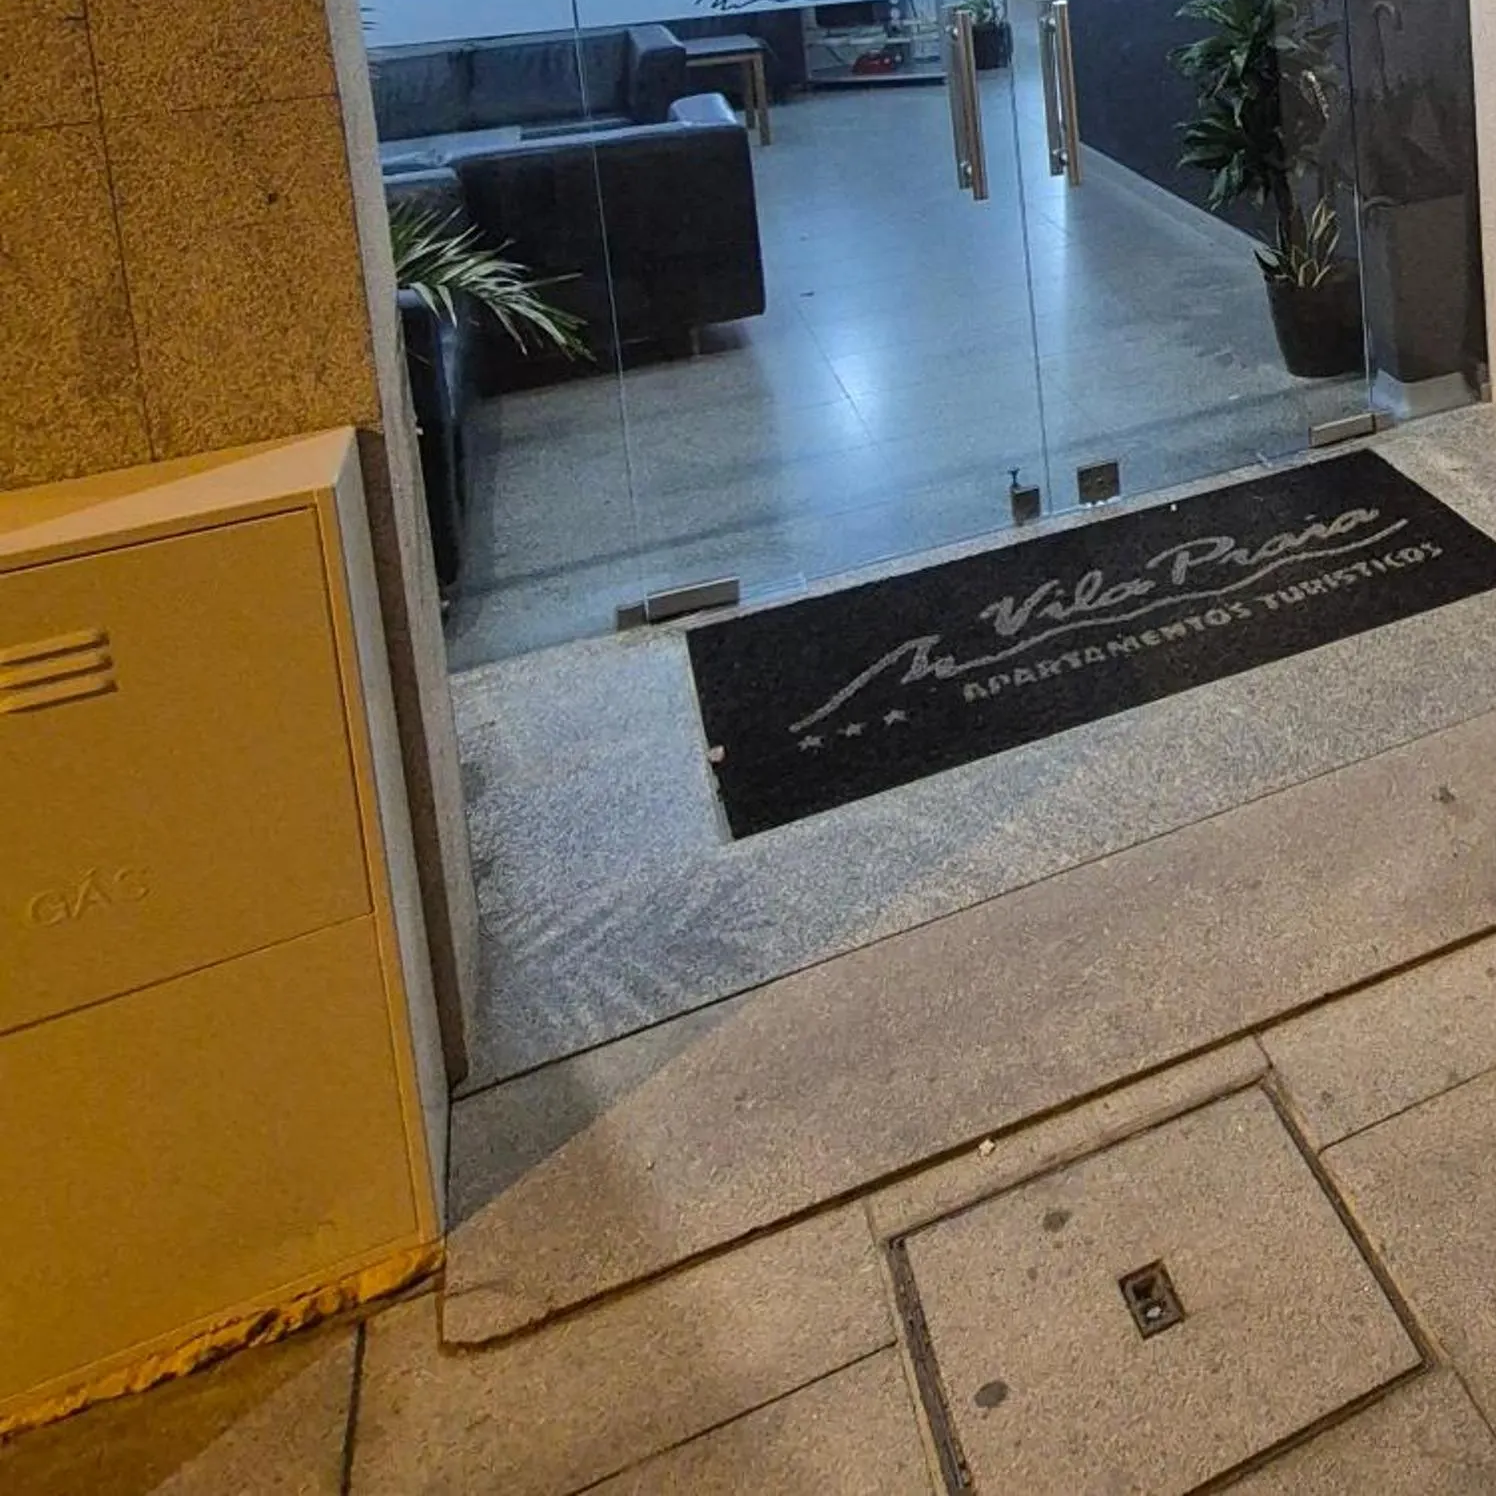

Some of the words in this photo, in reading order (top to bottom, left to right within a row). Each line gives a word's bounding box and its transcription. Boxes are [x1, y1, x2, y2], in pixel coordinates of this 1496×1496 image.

[979, 569, 1157, 637] Vila
[1145, 507, 1381, 586] Praia
[963, 601, 1253, 703] APARTAMENTOS
[28, 865, 152, 929] GÁS
